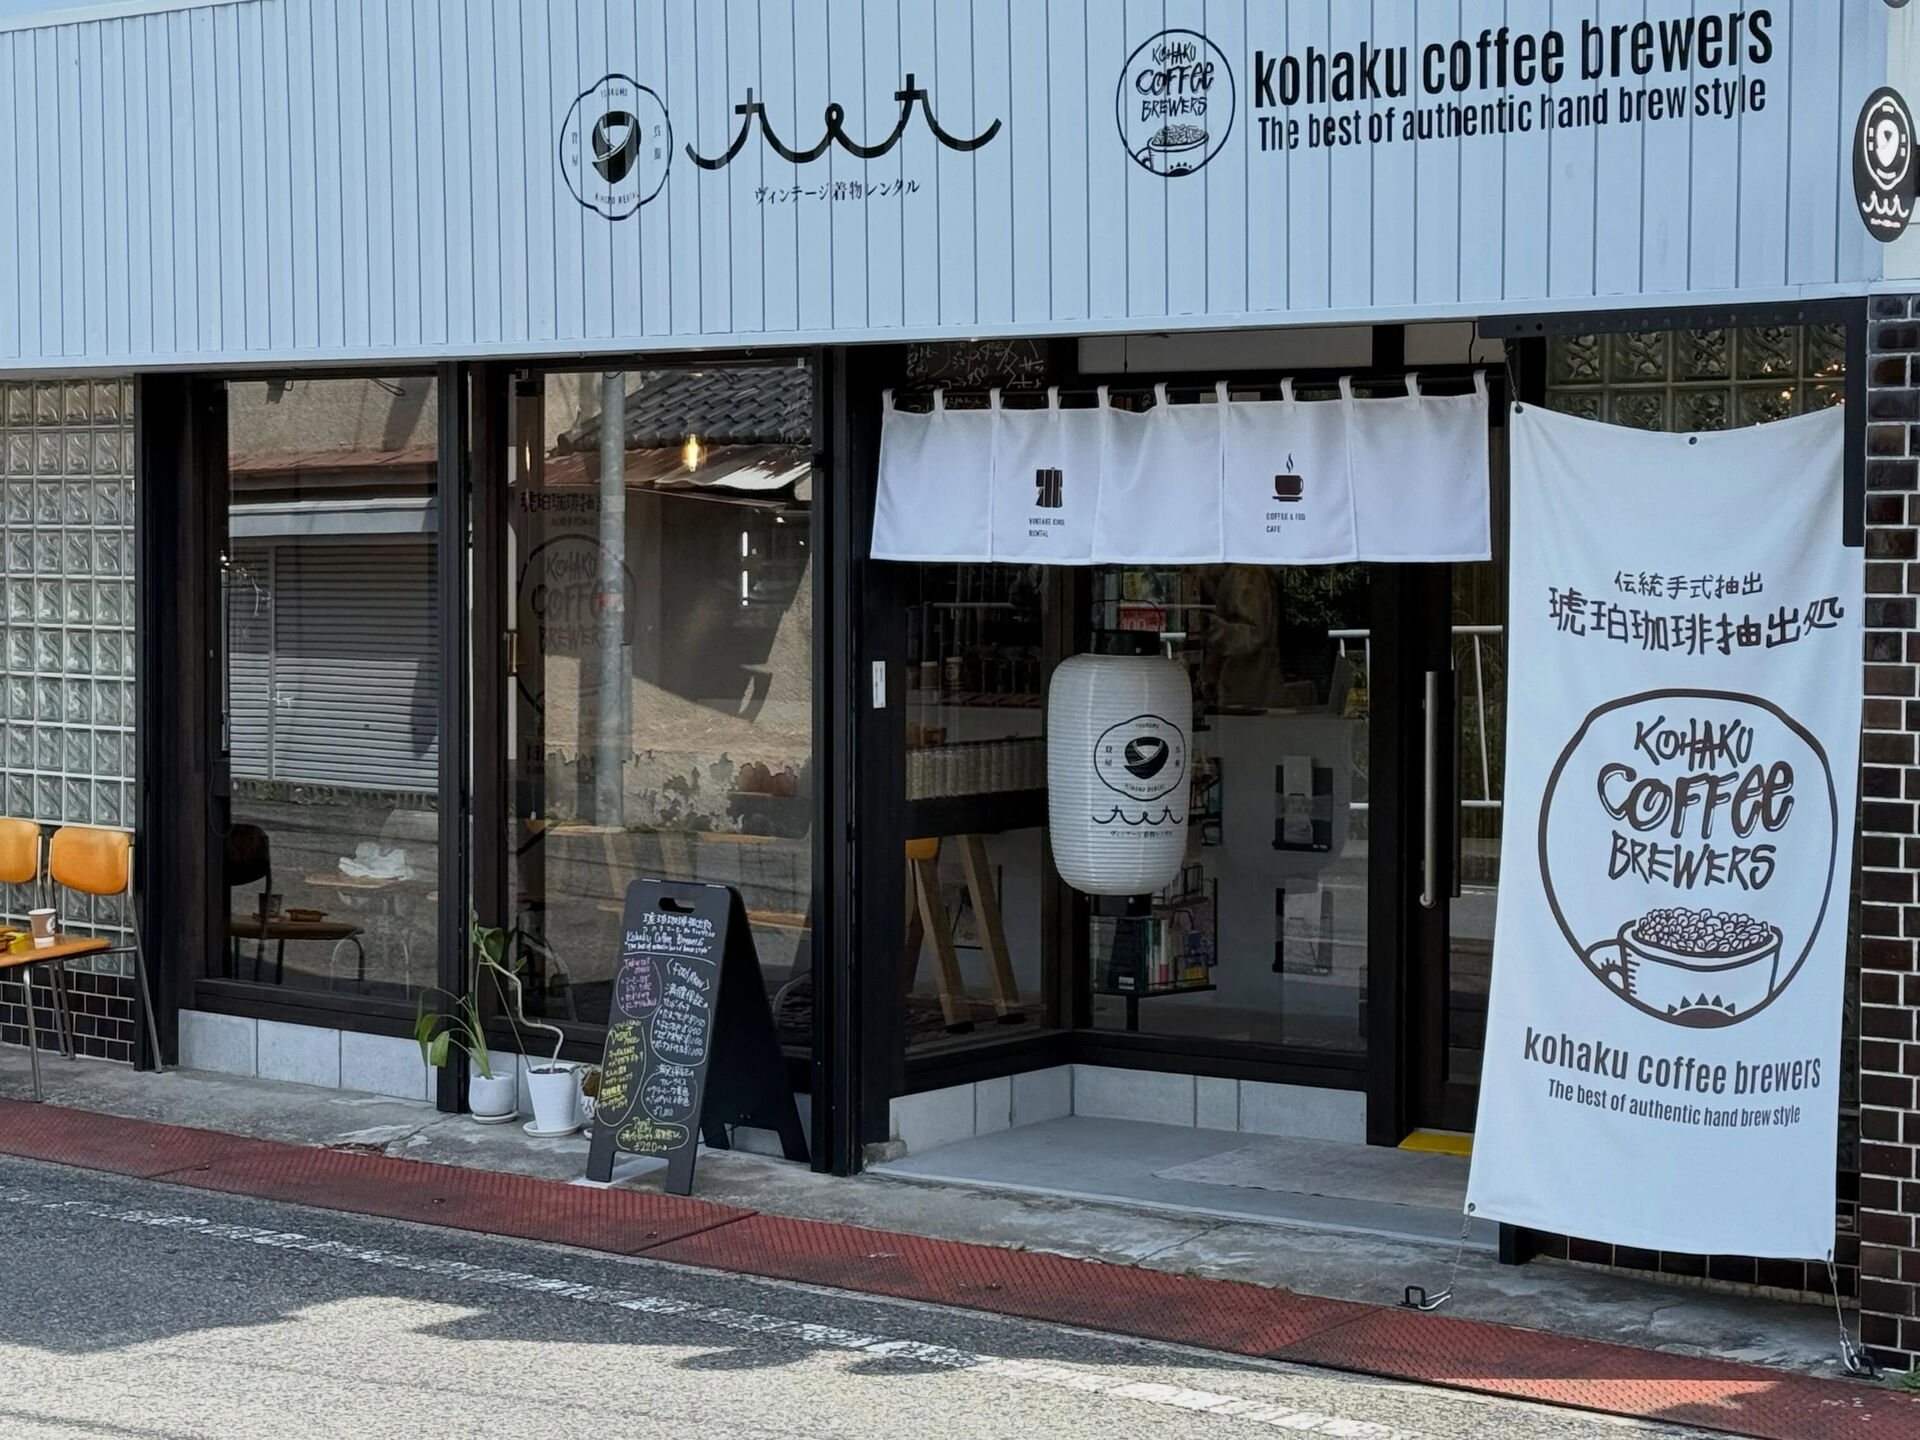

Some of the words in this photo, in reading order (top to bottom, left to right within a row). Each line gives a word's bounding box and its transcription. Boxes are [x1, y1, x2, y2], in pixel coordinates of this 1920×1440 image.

[1255, 41, 1407, 108] kohaku
[1423, 26, 1564, 94] coffee
[1581, 9, 1773, 80] brewers
[1141, 96, 1207, 122] BREWERS
[1258, 116, 1299, 151] The
[1308, 110, 1361, 148] best
[1368, 107, 1395, 143] of
[1402, 94, 1532, 141] authentic
[1540, 88, 1608, 130] hand
[1619, 86, 1686, 123] brew
[1694, 75, 1766, 119] style
[755, 178, 921, 205] ヴィンテージ着物レンタル
[1614, 571, 1764, 600] 伝統手式抽出
[1549, 587, 1845, 655] 琥珀珈琲抽出処
[1634, 716, 1753, 771] KOHAKU
[1608, 830, 1777, 891] BREWERS
[1523, 1026, 1629, 1080] kohaku
[1637, 1055, 1726, 1094] coffee
[1733, 1057, 1821, 1095] brewers
[1548, 1078, 1573, 1102] The
[1576, 1086, 1607, 1109] best
[1610, 1094, 1627, 1113] of
[1628, 1098, 1701, 1126] authentic
[1703, 1106, 1738, 1128] hand
[1740, 1107, 1772, 1127] brew
[1773, 1104, 1801, 1128] style
